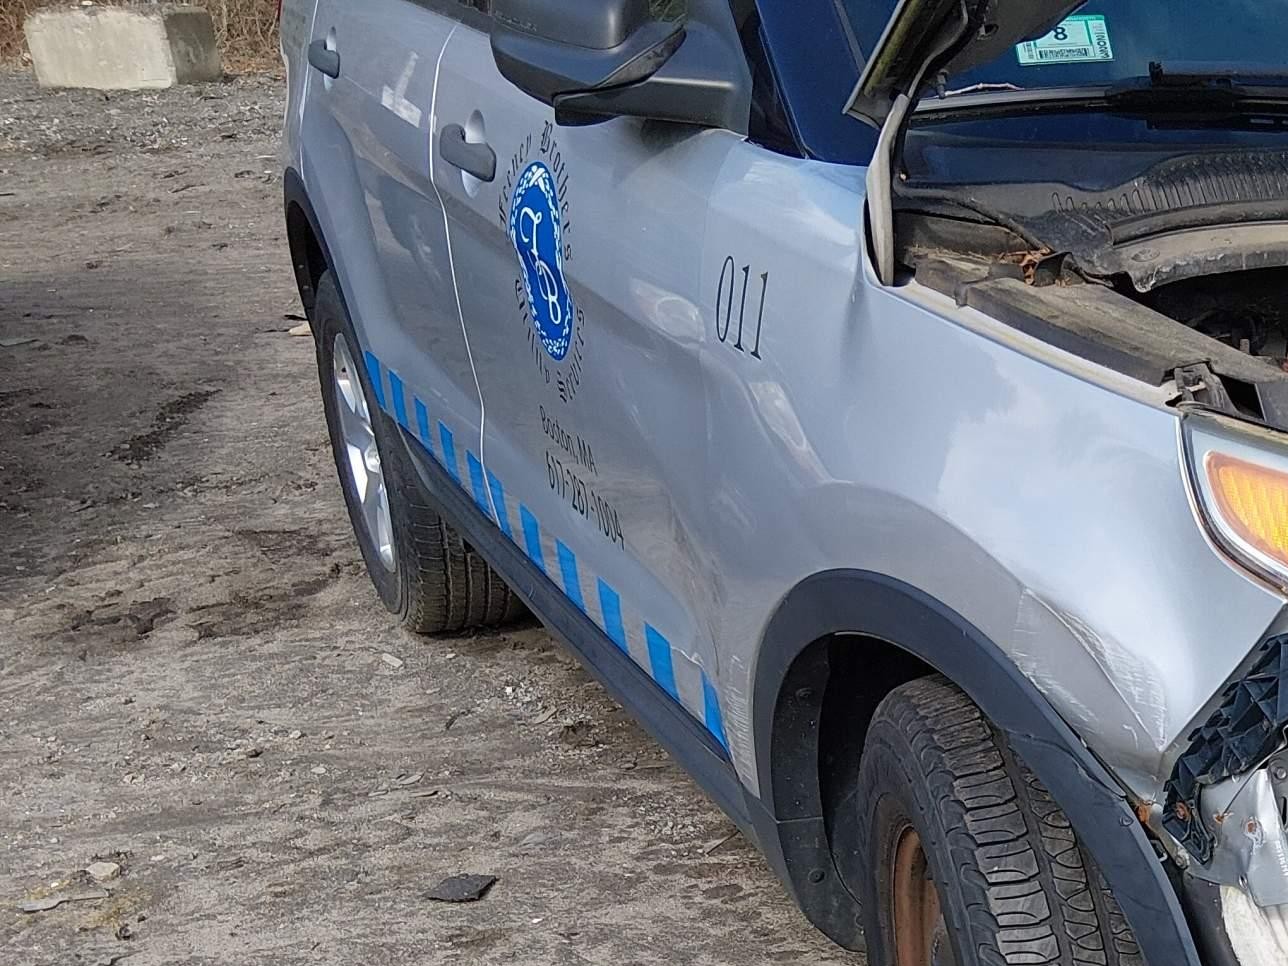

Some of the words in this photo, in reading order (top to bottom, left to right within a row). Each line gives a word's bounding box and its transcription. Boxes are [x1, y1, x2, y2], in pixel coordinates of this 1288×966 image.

[539, 119, 573, 262] Brothers
[715, 255, 769, 361] 011
[545, 450, 625, 552] 617-287-1004
